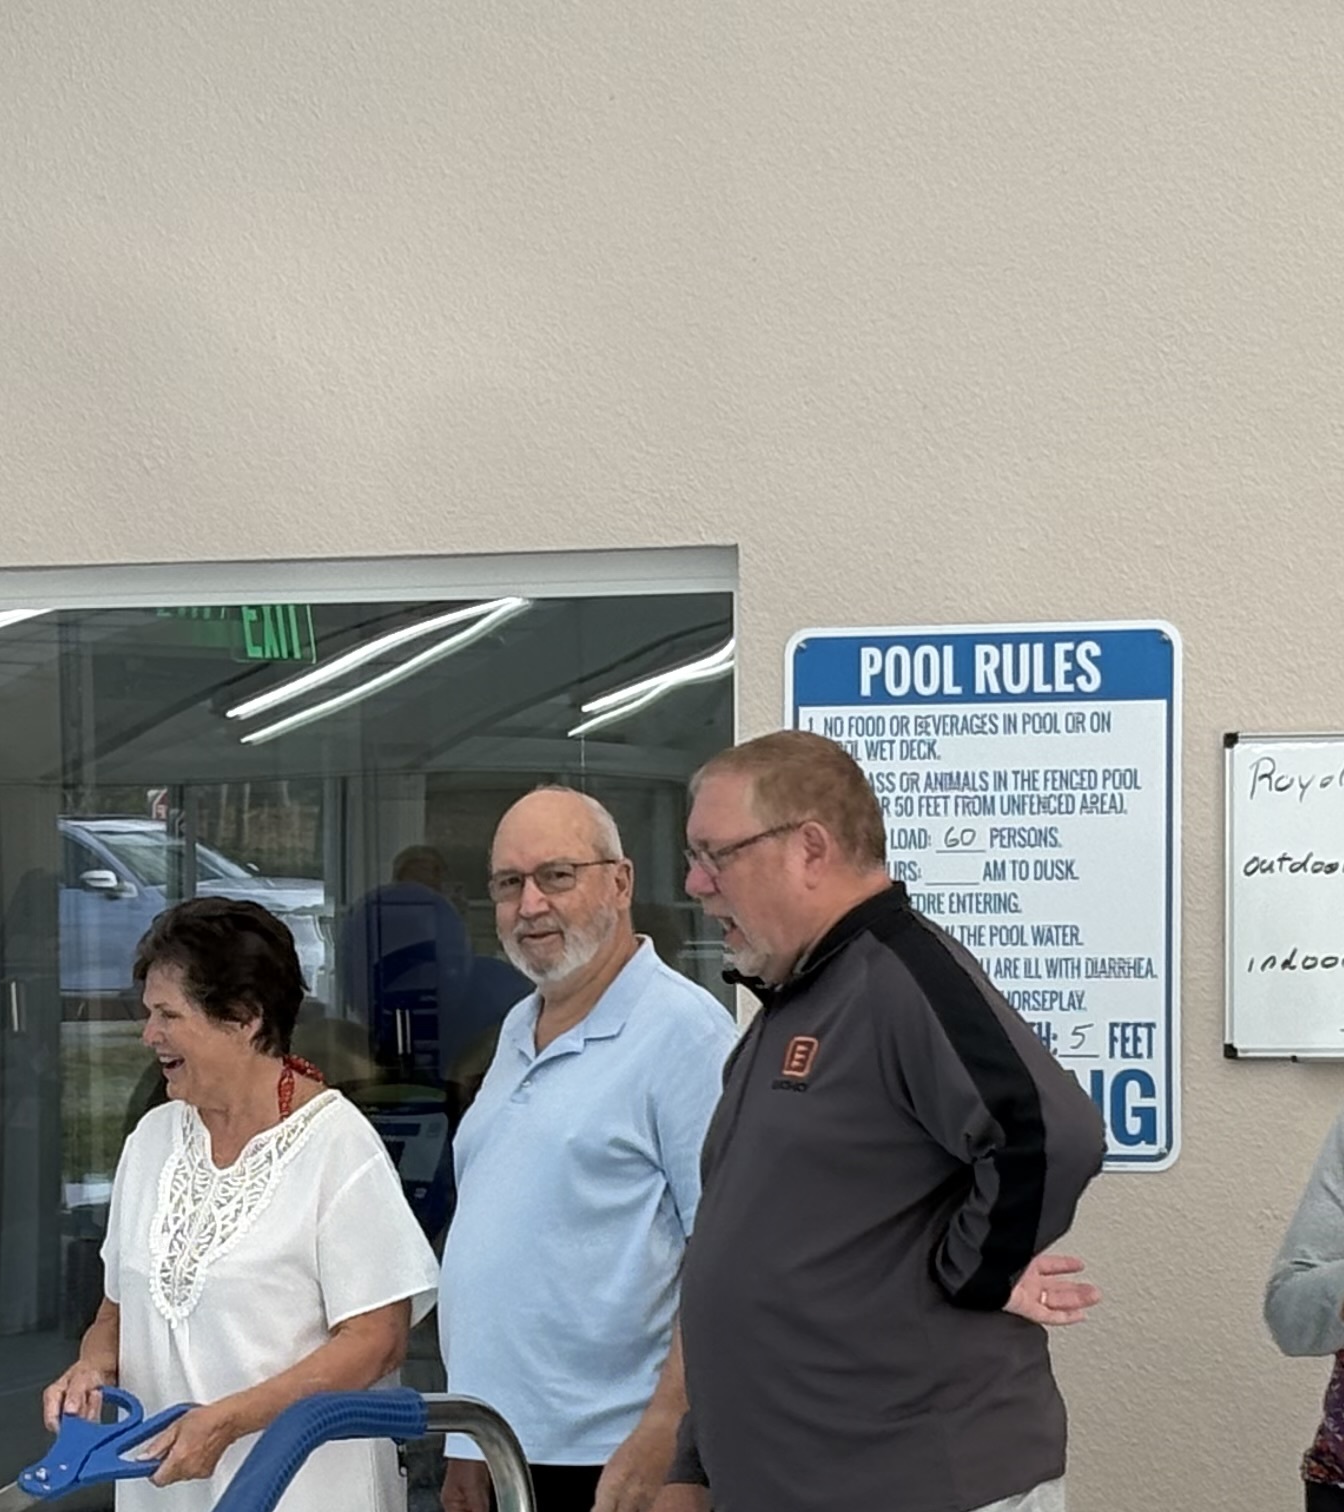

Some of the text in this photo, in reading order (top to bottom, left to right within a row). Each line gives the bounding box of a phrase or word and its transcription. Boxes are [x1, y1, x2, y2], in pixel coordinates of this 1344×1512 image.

[859, 640, 1102, 698] POOL RULES
[823, 711, 1112, 736] NO FOOD OR BEVERAGES IN POOL OR ON
[865, 740, 894, 761] WET
[899, 769, 1142, 792] OR ANIMALS IN THE FENCED POOL
[894, 797, 914, 817] 50
[917, 797, 948, 817] FEET
[954, 796, 995, 816] FROM
[999, 795, 1075, 816] UNFENCED
[944, 826, 976, 848] 60
[983, 860, 1006, 880] AM
[1011, 860, 1029, 880] TO
[959, 926, 985, 946] THE
[989, 926, 1027, 946] POOL
[994, 958, 1020, 979] ARE
[1023, 958, 1042, 979] ILL
[1045, 958, 1081, 978] WITH
[1070, 1022, 1156, 1059] 5 FEET
